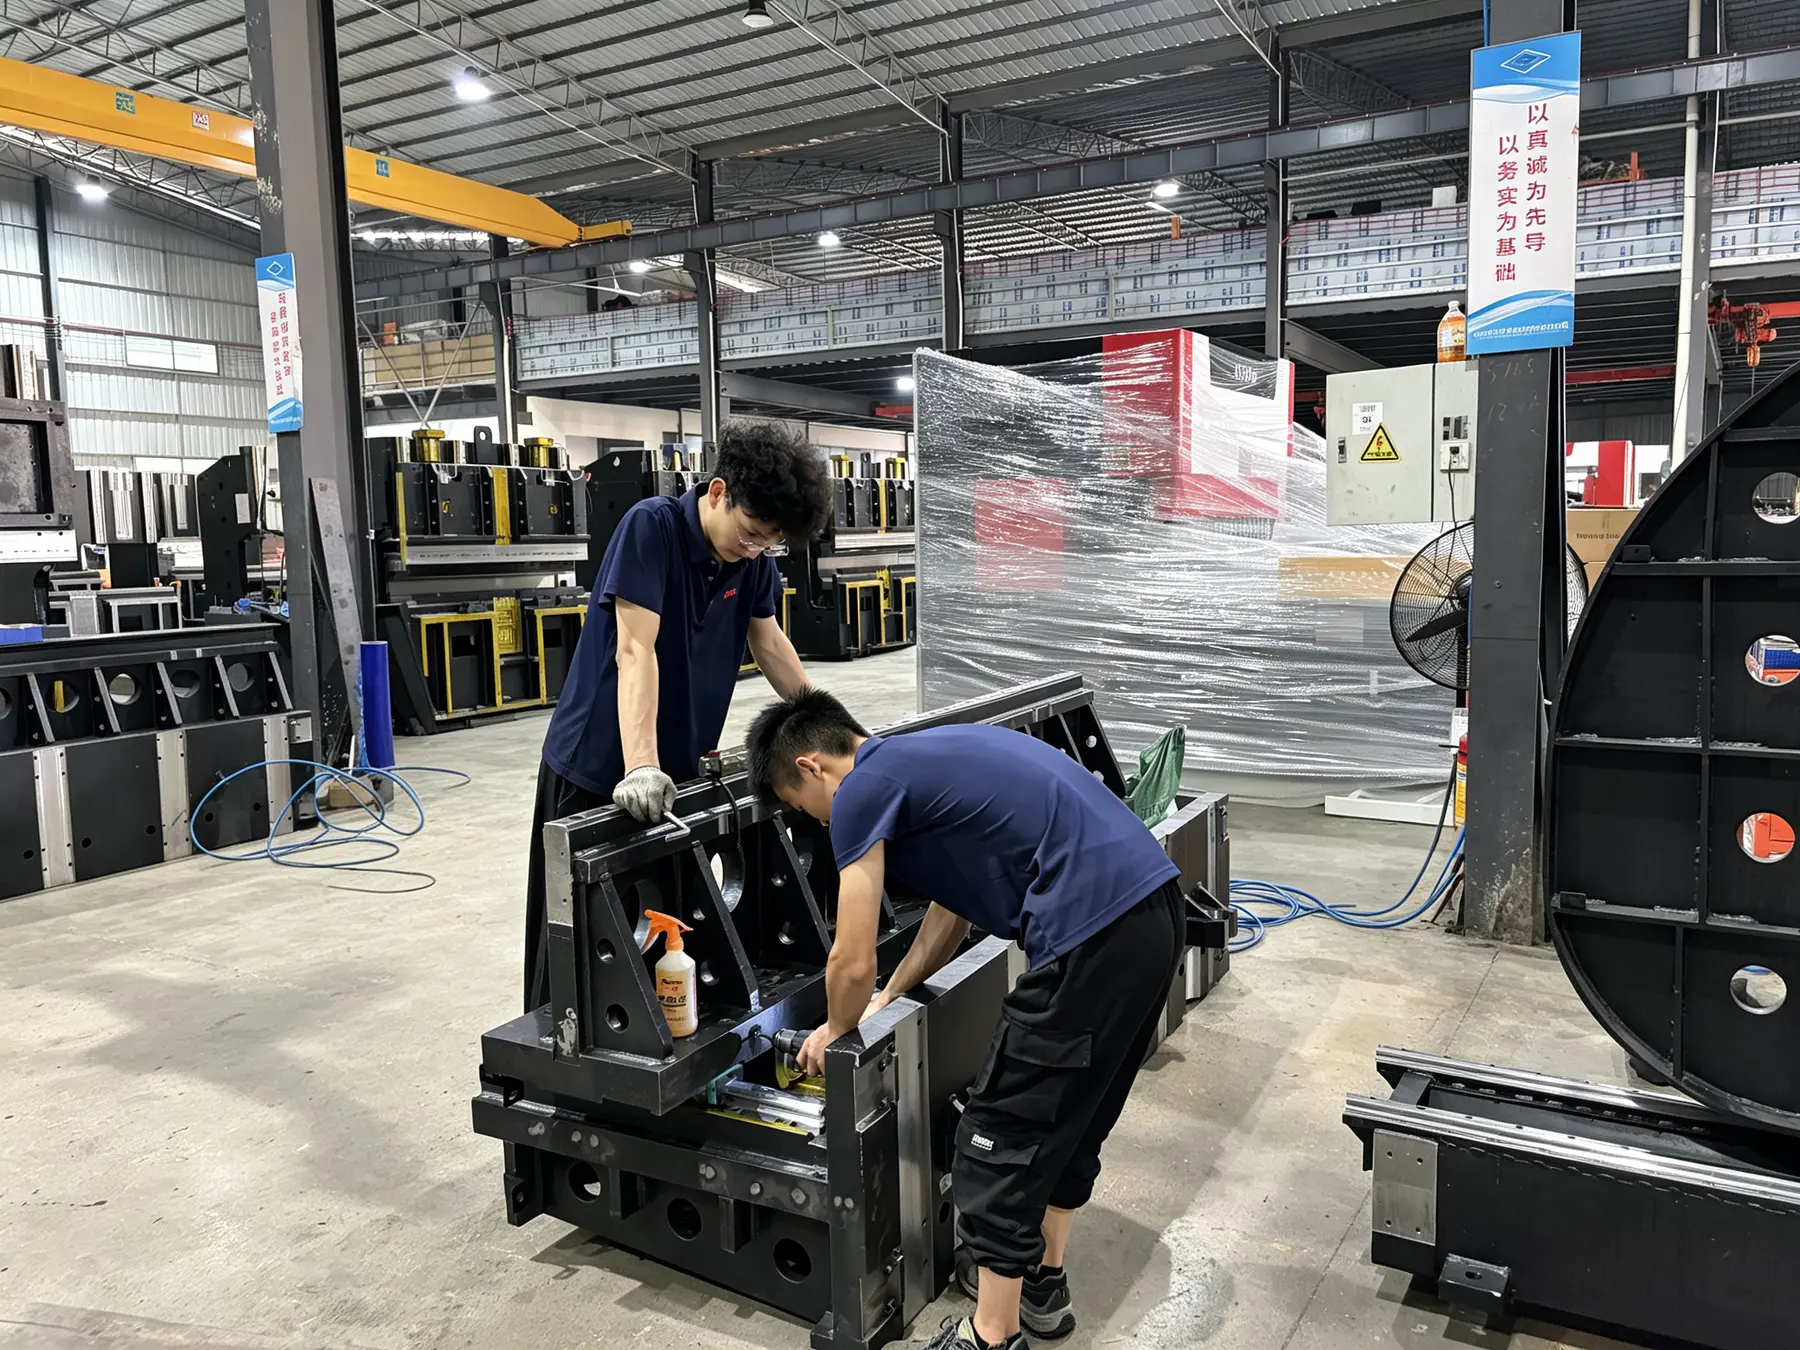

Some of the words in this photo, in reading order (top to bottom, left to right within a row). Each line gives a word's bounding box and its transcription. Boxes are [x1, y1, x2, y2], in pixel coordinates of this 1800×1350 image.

[1495, 134, 1519, 282] 以务实为基础
[1525, 103, 1549, 251] 以真诚为先导
